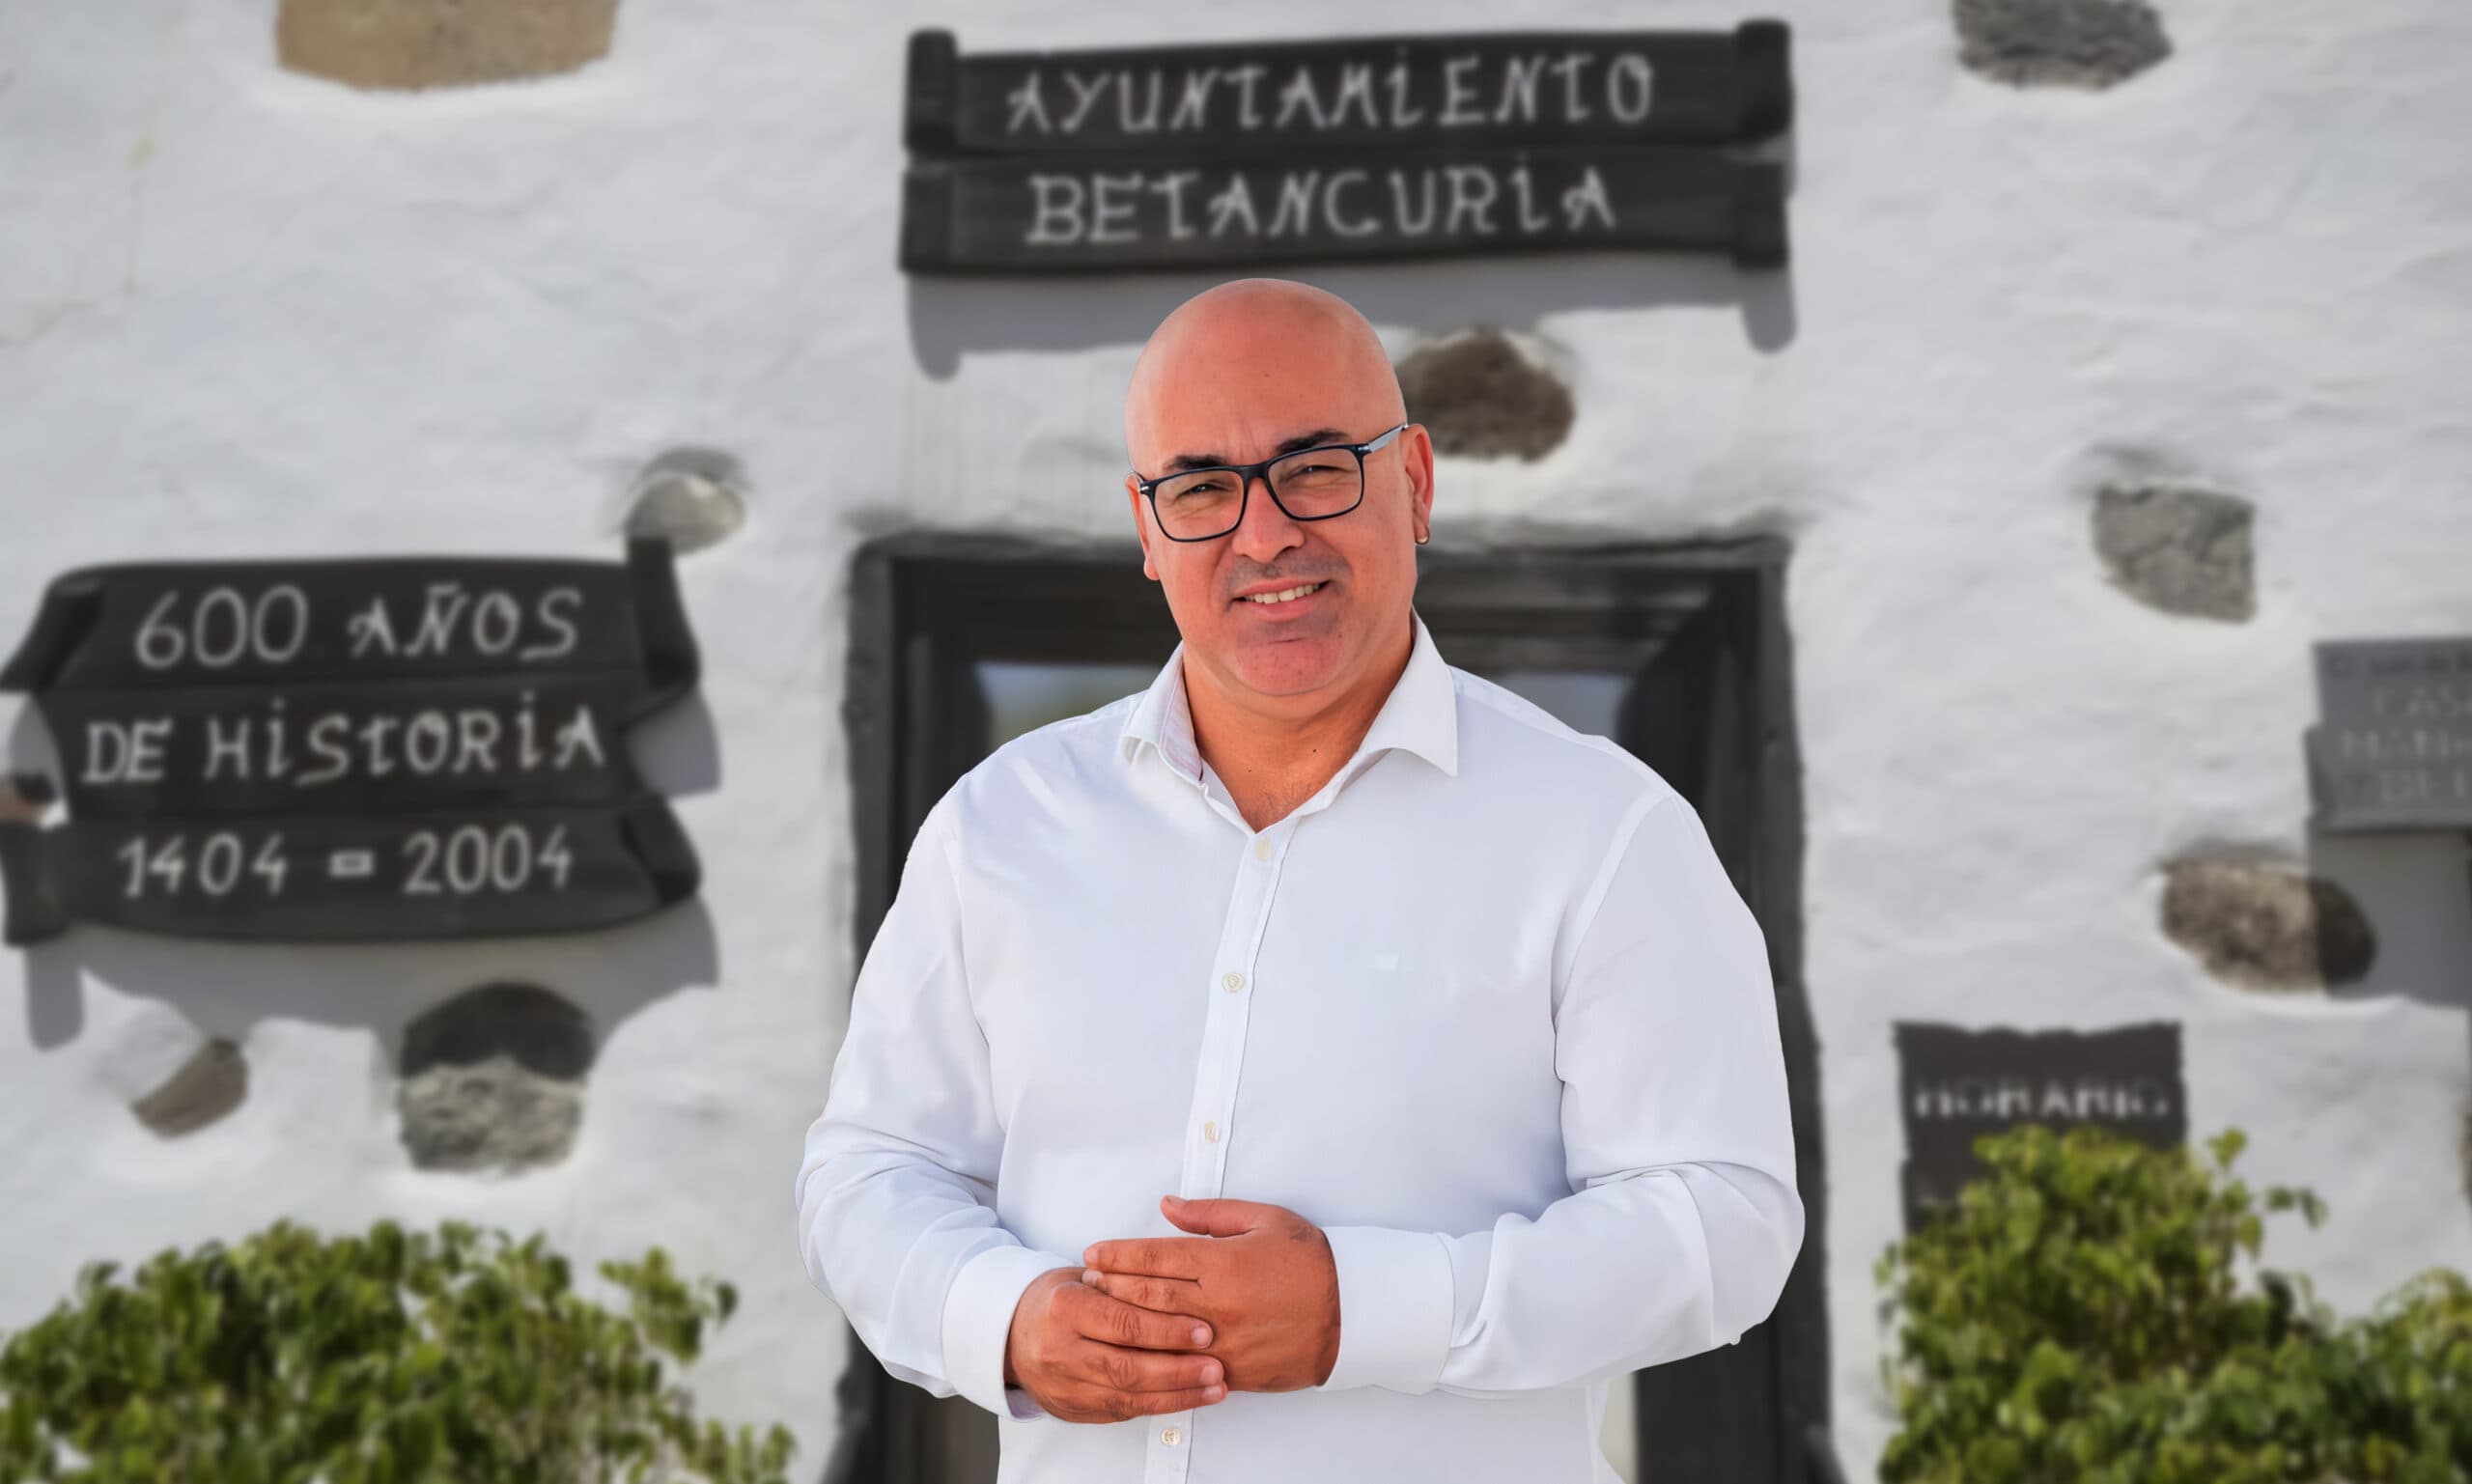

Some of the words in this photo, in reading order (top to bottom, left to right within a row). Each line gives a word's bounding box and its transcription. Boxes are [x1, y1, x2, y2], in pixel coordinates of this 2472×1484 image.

[136, 585, 308, 669] 600
[348, 580, 583, 660] AÑOS
[83, 718, 172, 783] DE
[119, 833, 287, 898] 1404
[403, 824, 575, 895] 2004
[1913, 1077, 2170, 1118] HORARIO
